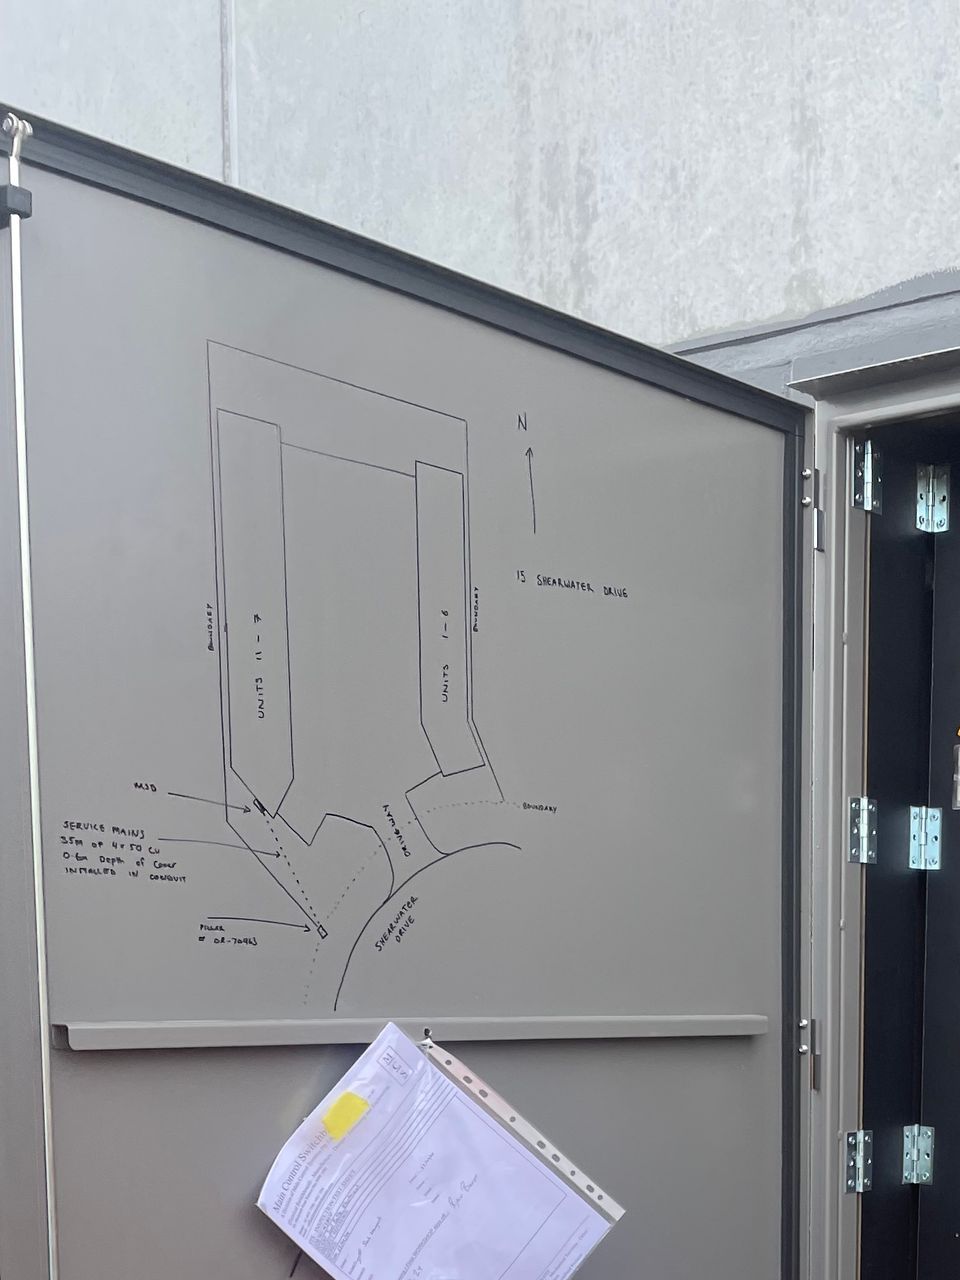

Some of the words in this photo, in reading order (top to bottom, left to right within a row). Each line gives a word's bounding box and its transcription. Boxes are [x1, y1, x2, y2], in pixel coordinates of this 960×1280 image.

[518, 412, 527, 430] N
[517, 570, 526, 583] 15
[537, 575, 594, 592] SHEARWATER
[603, 586, 628, 598] DRIVE
[256, 678, 264, 718] UNITS
[522, 802, 557, 813] BOUNDARY
[63, 821, 104, 832] SERVICE
[112, 827, 144, 838] MAINS
[100, 856, 124, 866] Depth
[375, 896, 418, 952] SHEARWATER
[395, 915, 415, 943] DRIVE
[280, 1160, 302, 1192] Control
